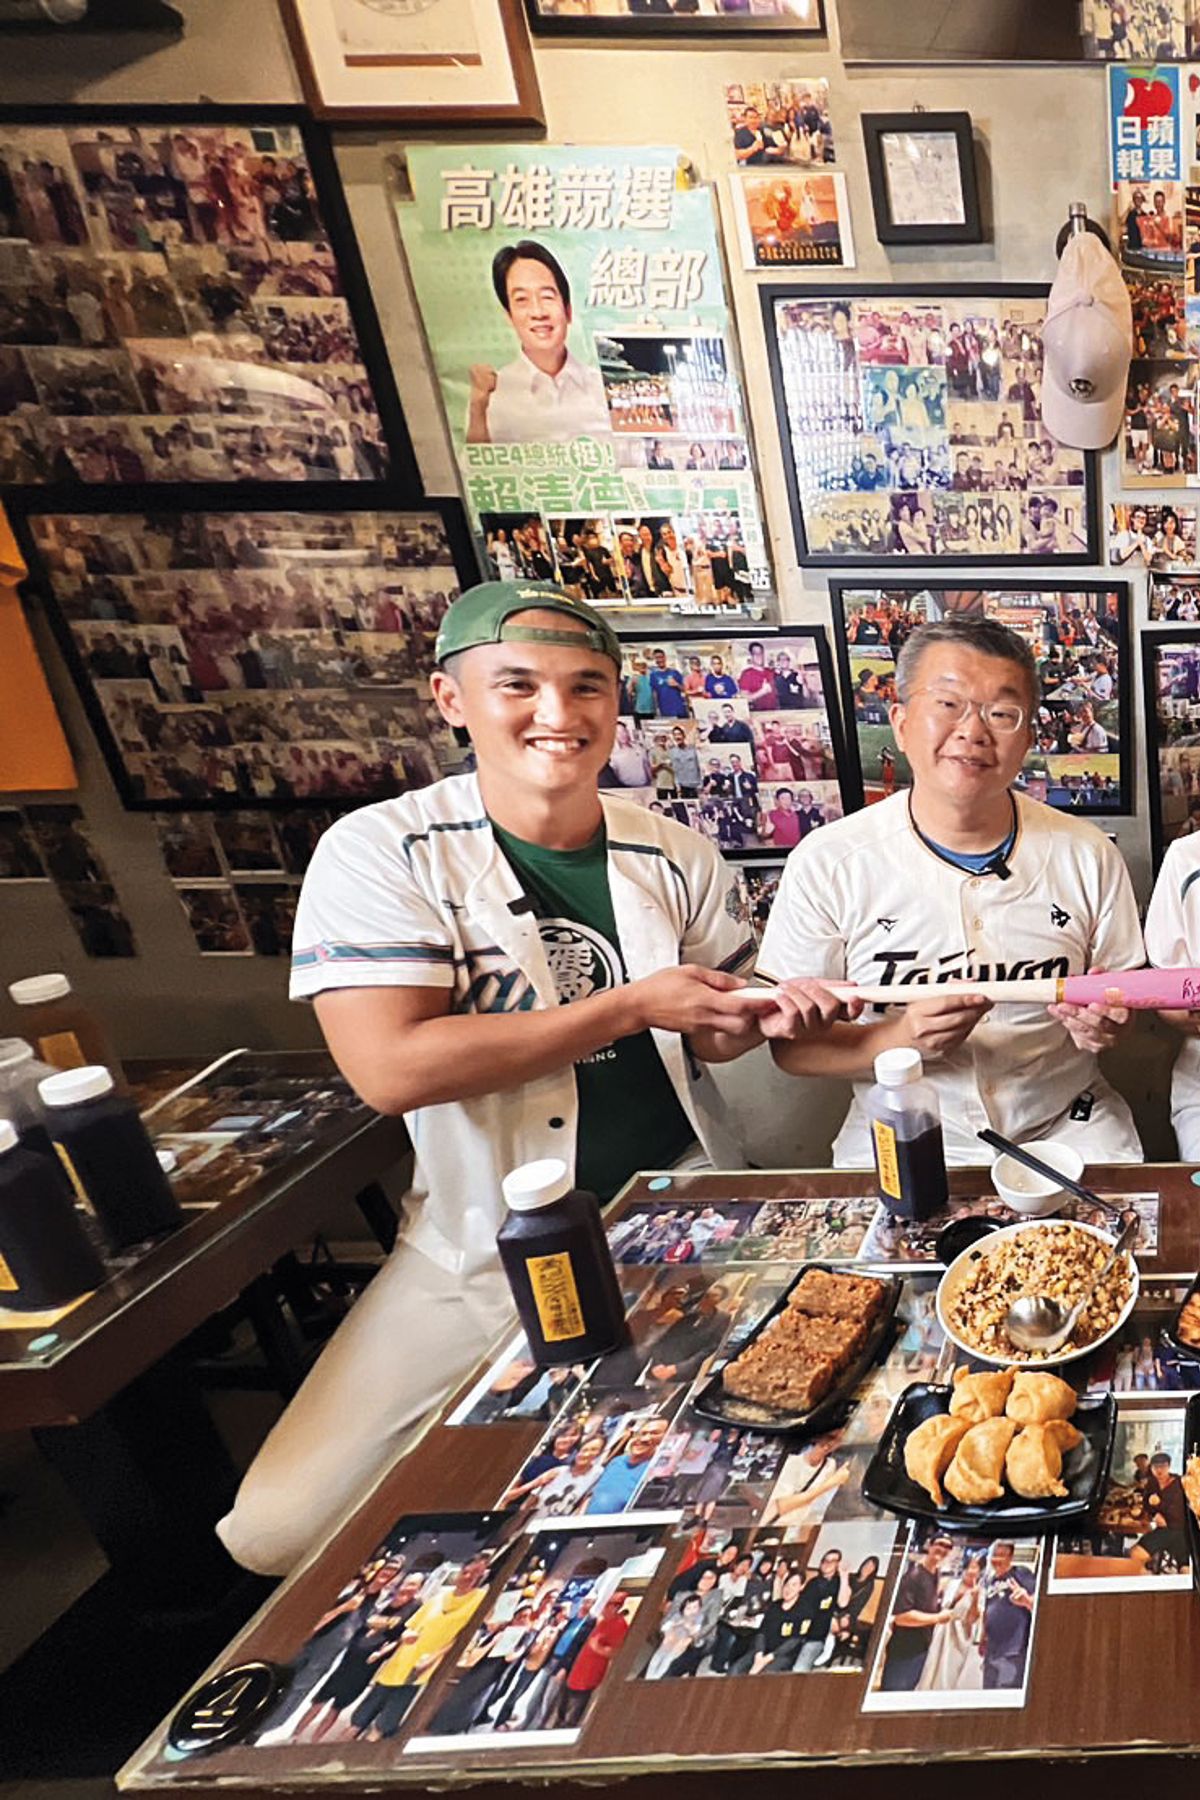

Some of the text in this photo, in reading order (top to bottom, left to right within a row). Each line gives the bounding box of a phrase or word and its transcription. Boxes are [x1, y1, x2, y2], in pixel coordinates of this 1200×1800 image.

[439, 163, 676, 231] 高雄競選
[586, 247, 709, 309] 總部
